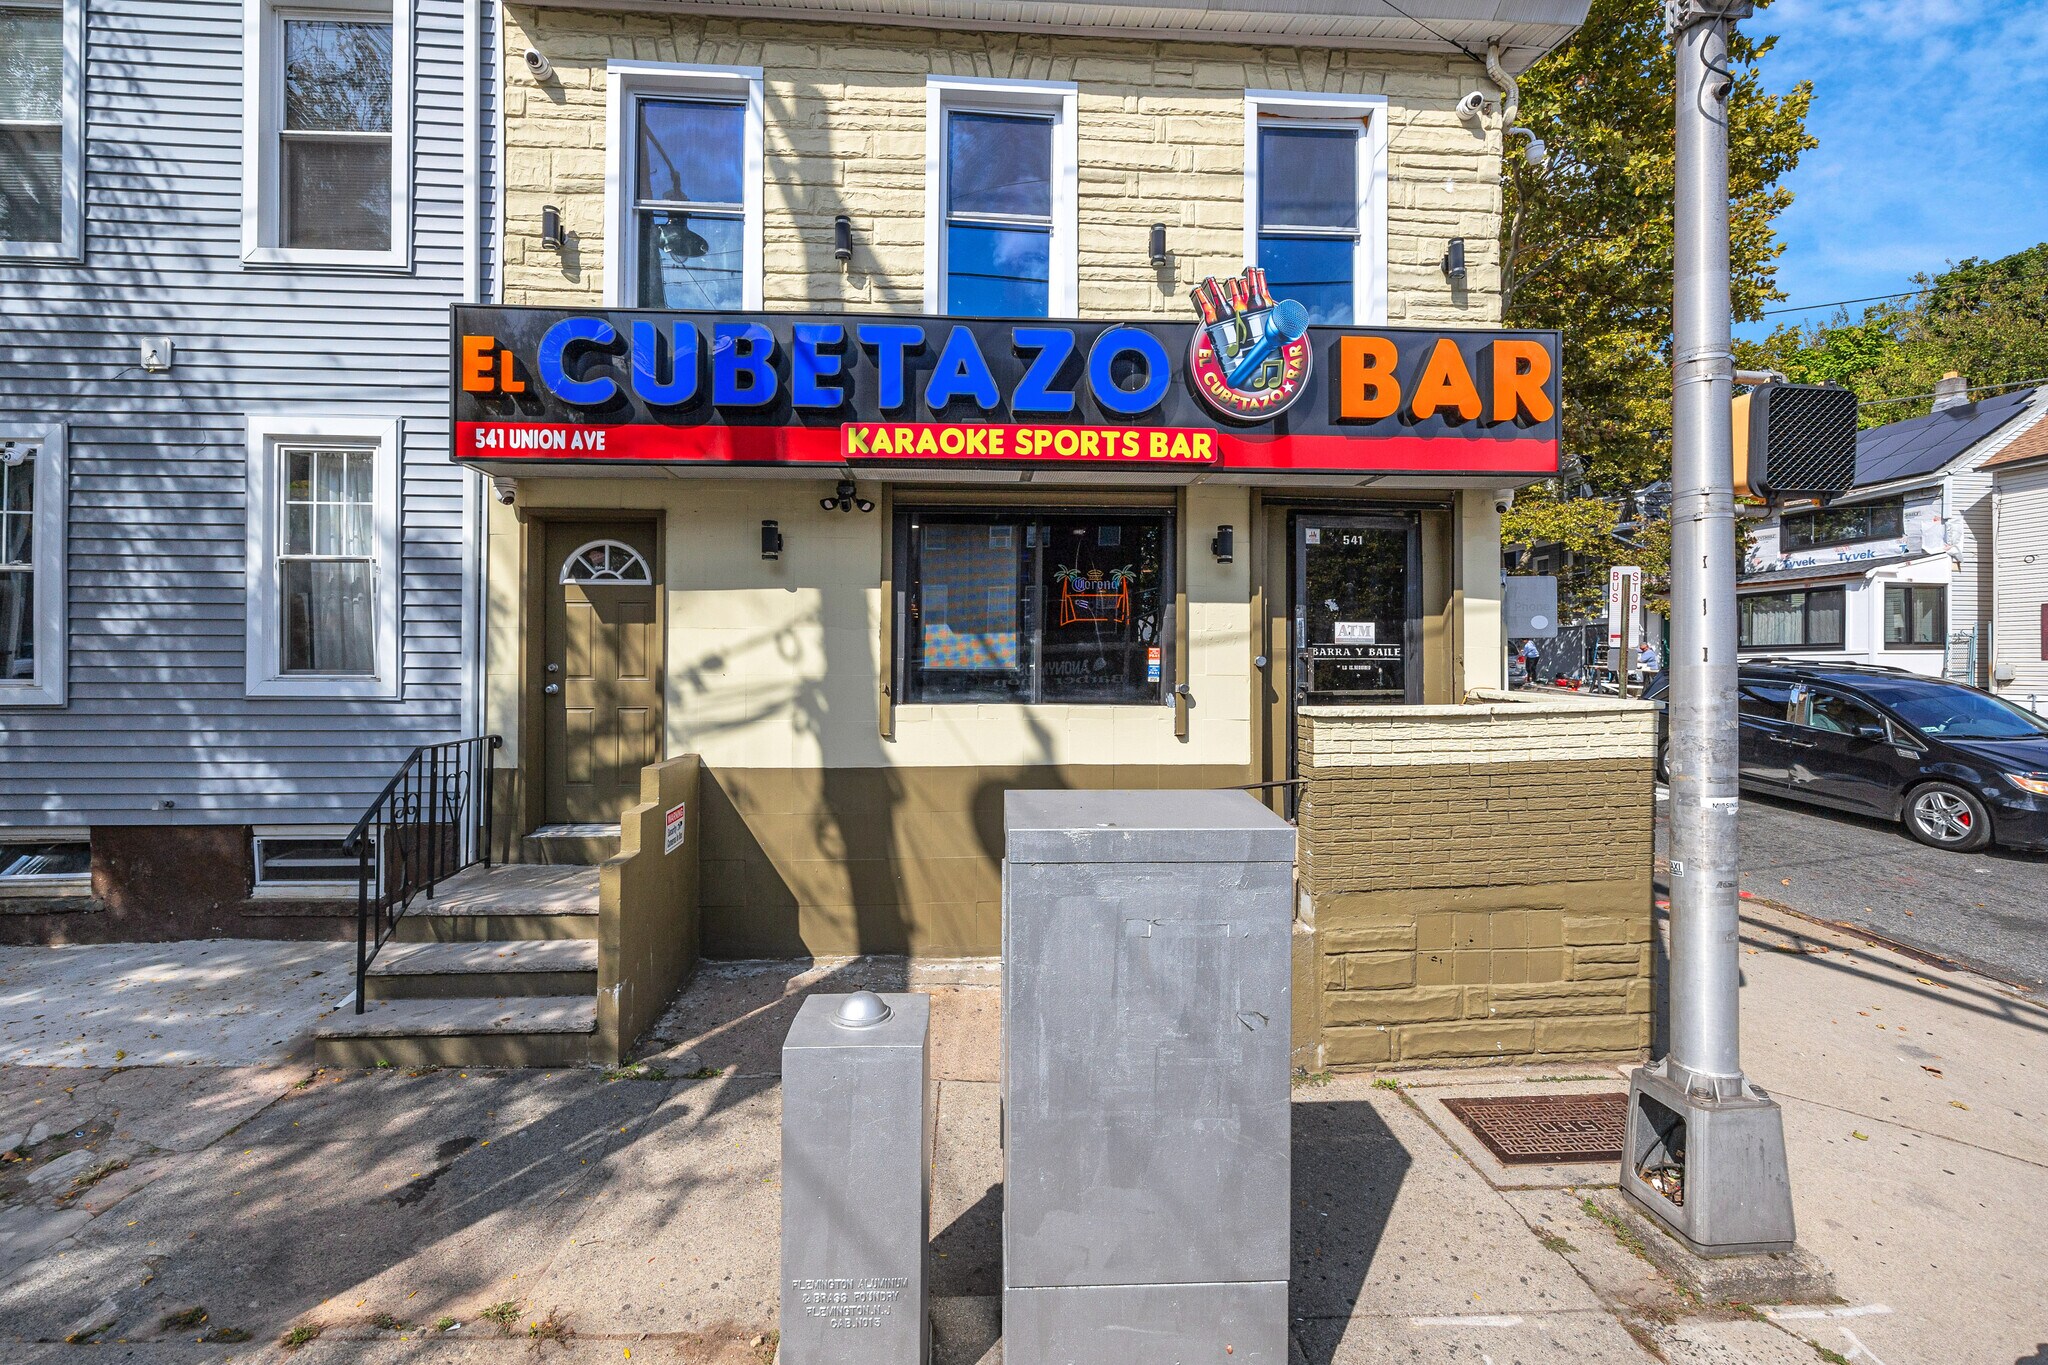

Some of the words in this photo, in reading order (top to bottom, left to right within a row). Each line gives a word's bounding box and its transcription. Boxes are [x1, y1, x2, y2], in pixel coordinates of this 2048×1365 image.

[1198, 348, 1213, 368] EL
[1286, 344, 1303, 380] BAR
[462, 335, 525, 393] EL
[537, 316, 1171, 414] CUBETAZO
[1340, 335, 1555, 423] BAR
[1203, 371, 1284, 412] CUBETAZO
[475, 427, 505, 449] 541
[509, 428, 567, 451] UNION
[571, 430, 606, 451] AVE
[847, 425, 1005, 456] KARAOKE
[1015, 429, 1141, 459] SPORTS
[1150, 433, 1213, 461] BAR
[1342, 535, 1363, 545] 541
[1837, 549, 1876, 562] Tyvek
[1072, 576, 1119, 592] Corona
[1631, 571, 1639, 614] STOP
[1337, 624, 1372, 637] ATM
[1312, 647, 1351, 657] BARRA
[1355, 647, 1363, 657] Y
[1369, 647, 1401, 657] BAILE
[792, 1278, 854, 1291] FLEMINGTON
[858, 1277, 909, 1289] ALUMINUM
[854, 1290, 900, 1303] FOUNDRY
